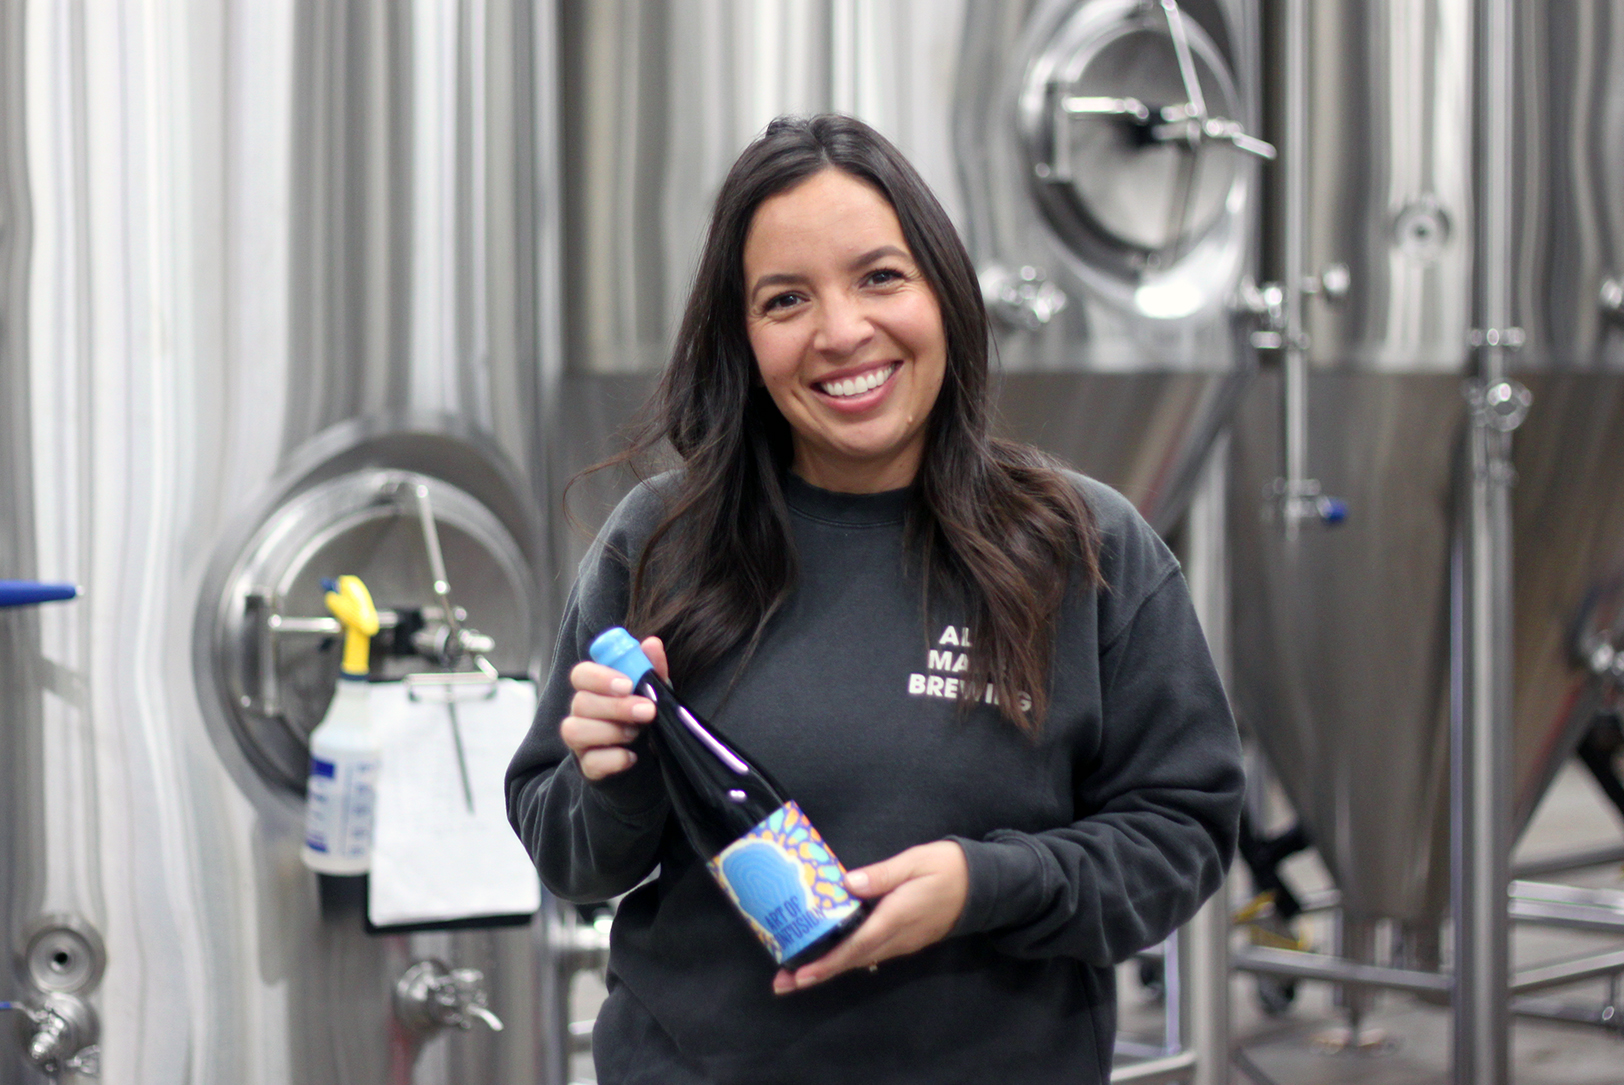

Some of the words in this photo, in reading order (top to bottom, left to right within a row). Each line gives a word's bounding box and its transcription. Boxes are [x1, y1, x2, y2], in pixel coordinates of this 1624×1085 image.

[938, 625, 972, 648] AL
[764, 905, 788, 930] ART
[784, 895, 802, 917] OF
[774, 907, 827, 949] INFUSION
